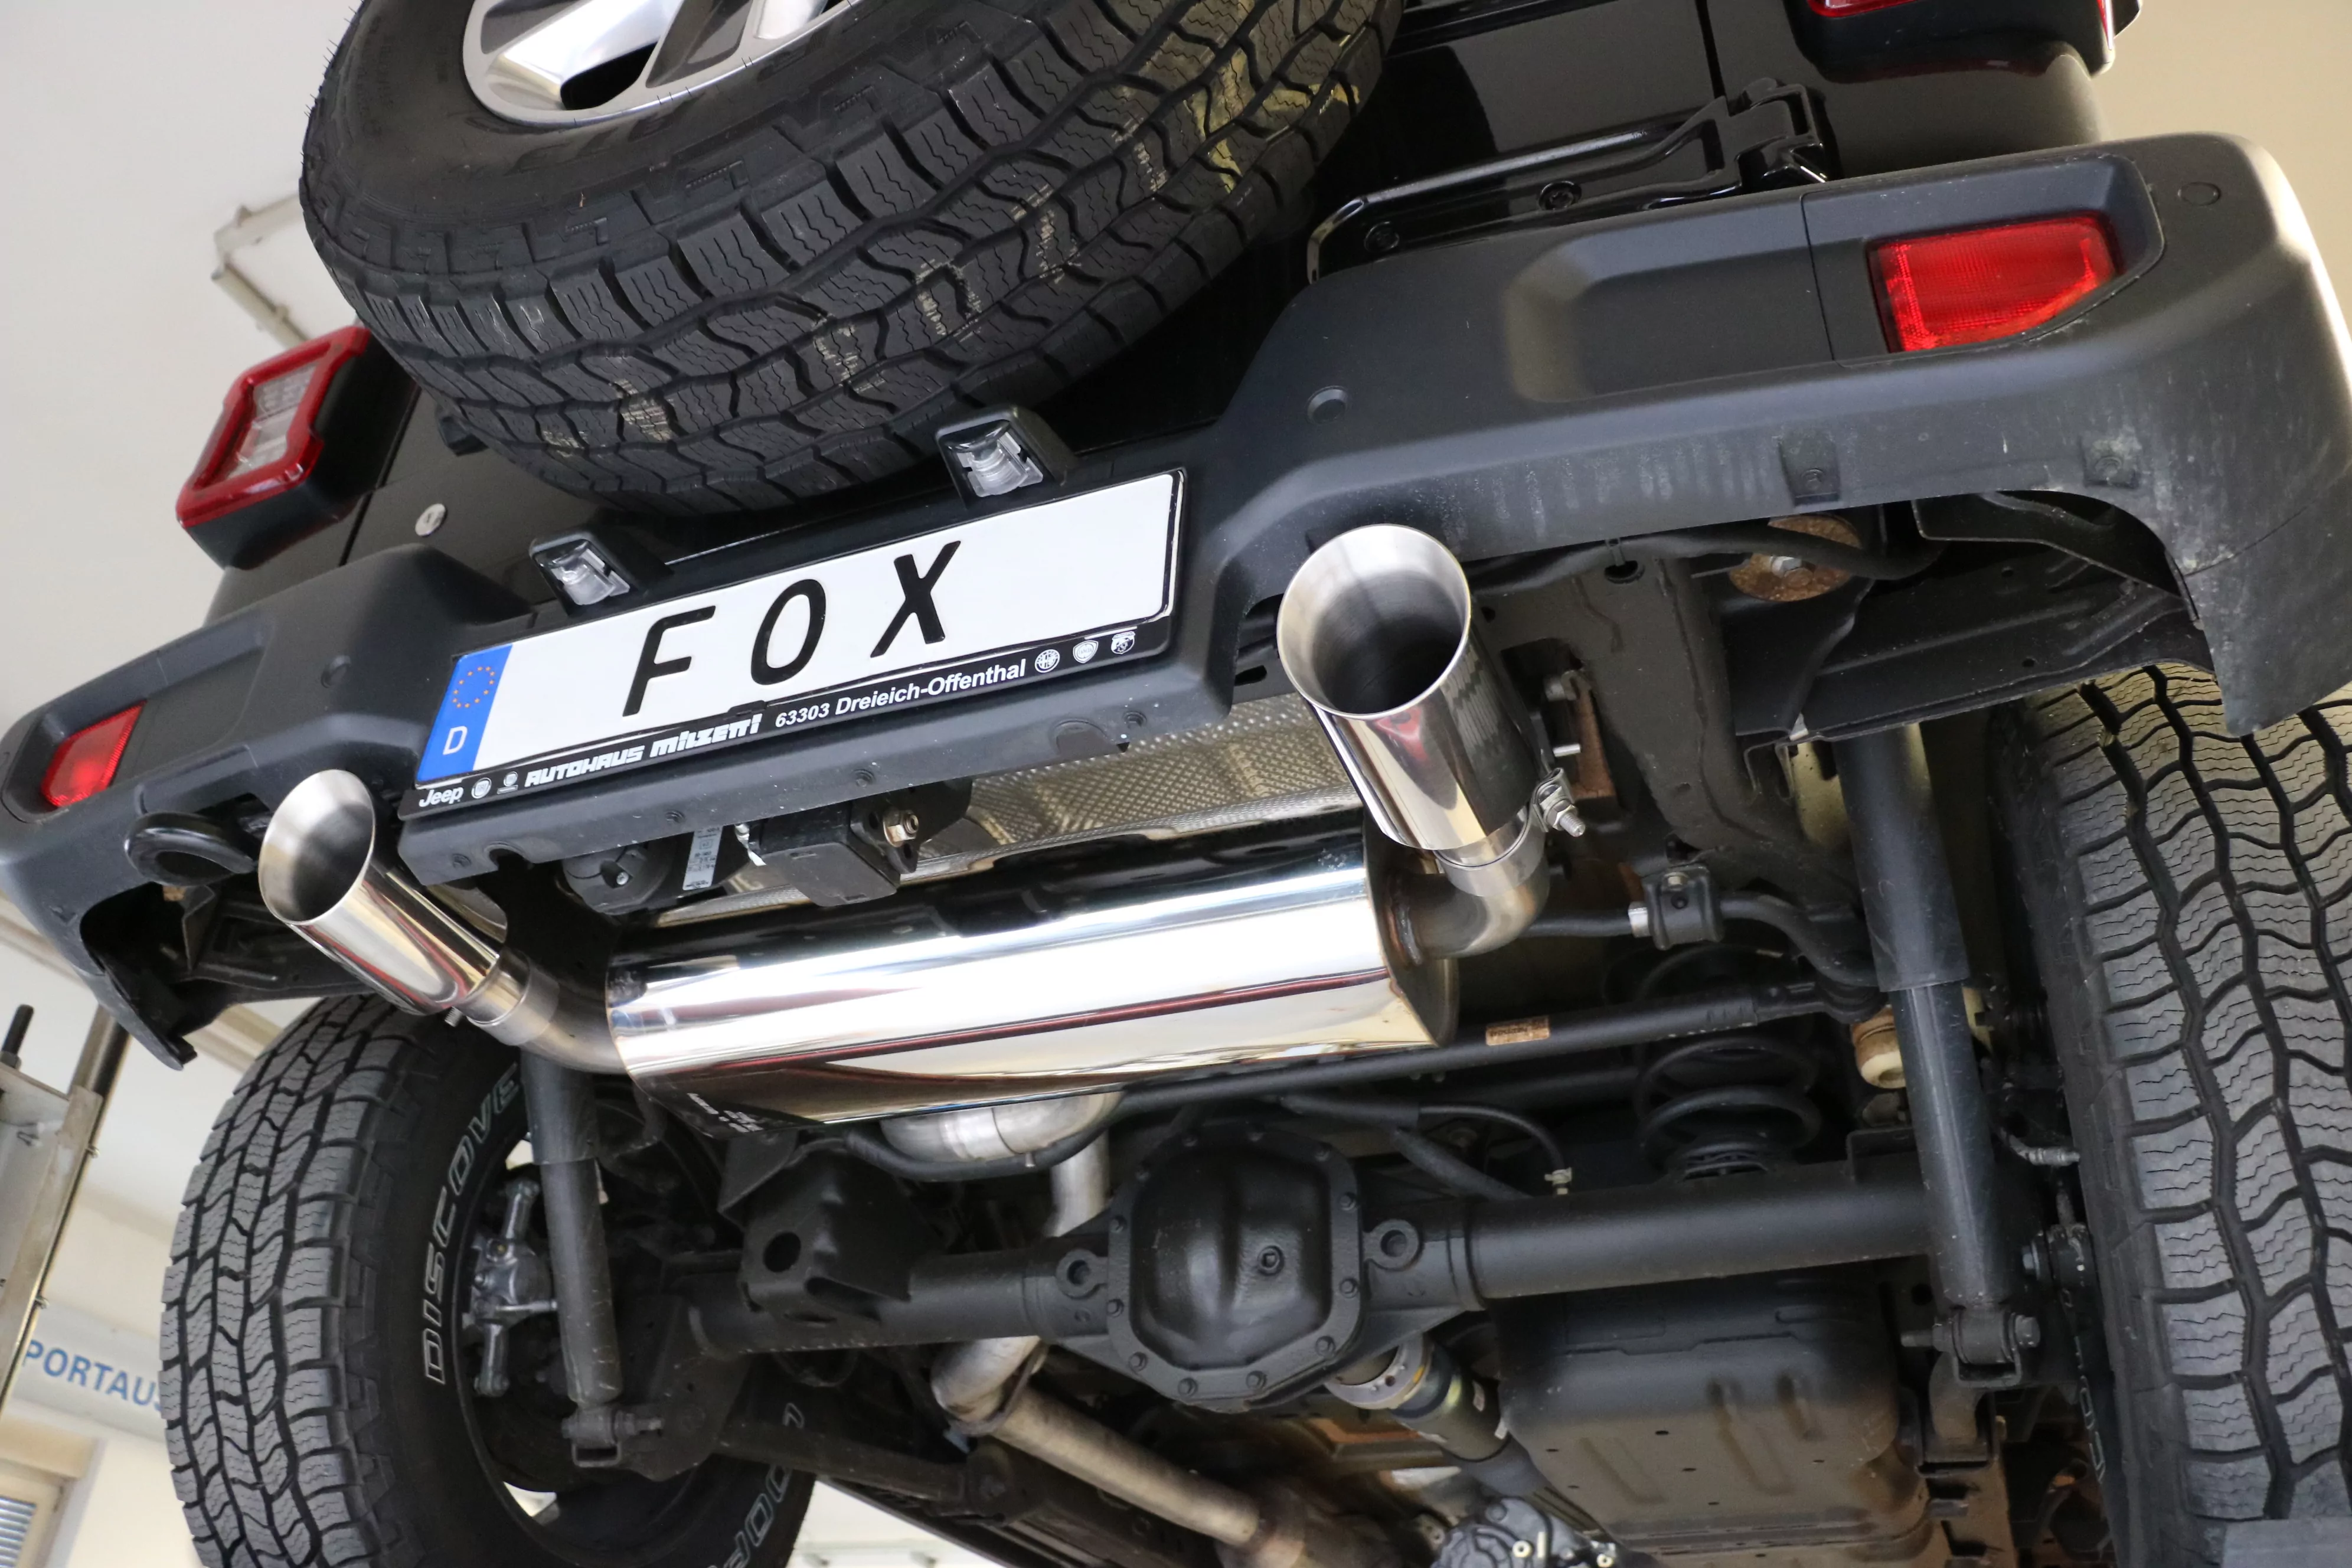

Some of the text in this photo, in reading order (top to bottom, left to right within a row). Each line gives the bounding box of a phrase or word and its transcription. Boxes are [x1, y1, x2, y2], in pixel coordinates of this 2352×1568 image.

[622, 541, 961, 717] FOX
[443, 725, 468, 755] D
[524, 744, 645, 788] AUTOHAUS
[775, 703, 830, 728] 63303
[835, 658, 1026, 716] Dreieich-Offenthal
[419, 786, 464, 808] Jeep
[22, 1339, 163, 1413] PORTAU
